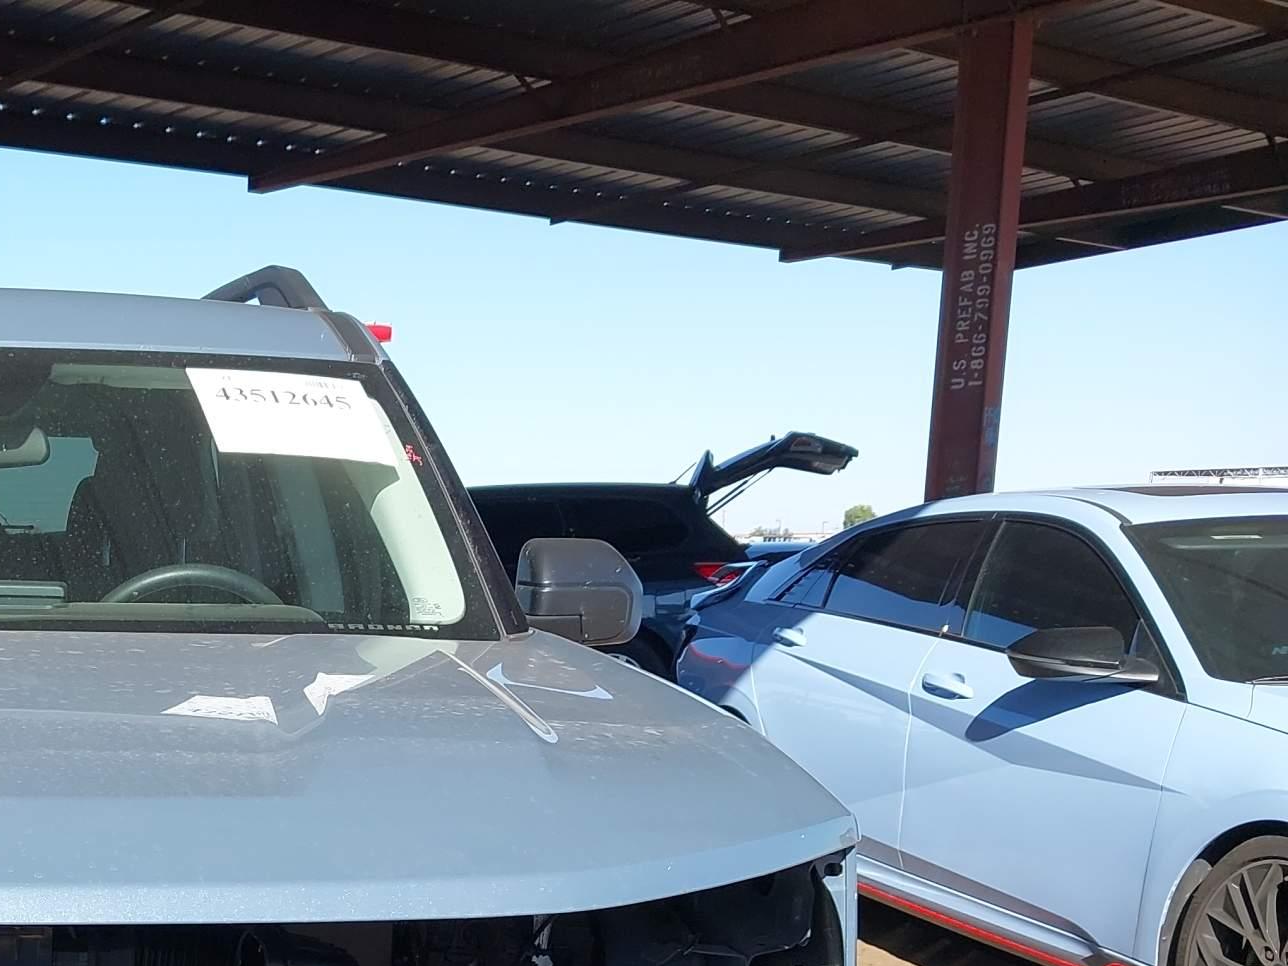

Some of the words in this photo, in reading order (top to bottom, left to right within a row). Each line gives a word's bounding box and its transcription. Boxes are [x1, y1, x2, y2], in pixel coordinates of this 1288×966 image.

[962, 223, 980, 260] INC.
[955, 269, 976, 343] PREFAB
[968, 223, 997, 387] 1-866-799-0969
[215, 386, 352, 410] 43512645
